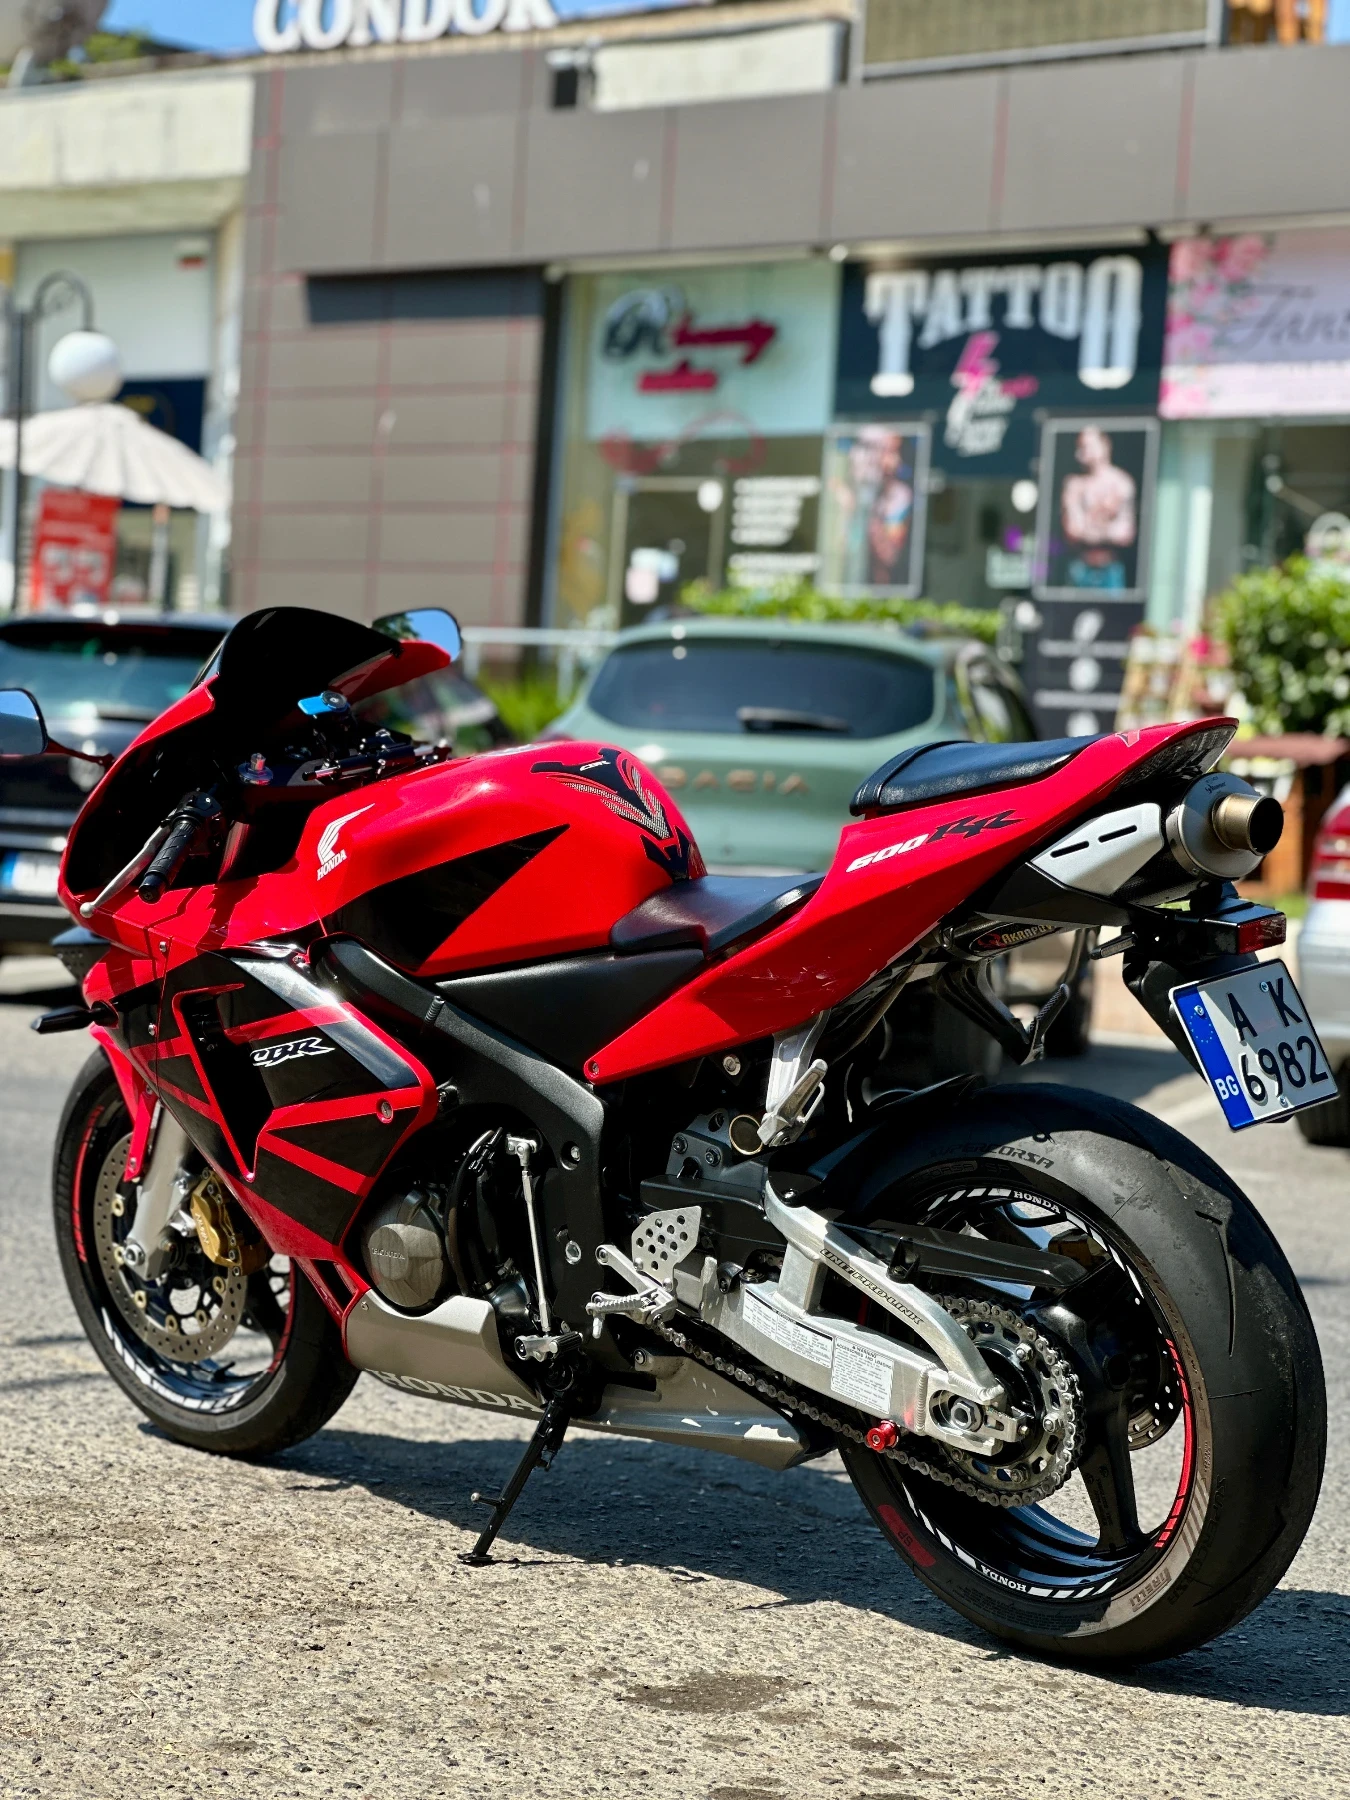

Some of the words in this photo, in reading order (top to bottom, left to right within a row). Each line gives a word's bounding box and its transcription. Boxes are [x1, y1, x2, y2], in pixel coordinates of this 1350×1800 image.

[863, 254, 1142, 396] TATTOO
[657, 766, 810, 796] DACIA
[317, 849, 347, 881] HONDA
[1001, 924, 1055, 945] AKRAPOV
[1228, 992, 1258, 1042] A
[1267, 977, 1303, 1028] K
[249, 1036, 336, 1068] CBR
[1241, 1035, 1329, 1103] 6982
[1214, 1074, 1240, 1100] BG
[1013, 1189, 1061, 1215] HONDA
[820, 1248, 855, 1275] UNIT
[364, 1368, 546, 1413] HONDA
[897, 1530, 914, 1547] SP
[979, 1564, 1028, 1593] HONDA
[1128, 1566, 1173, 1613] PIRELLI
